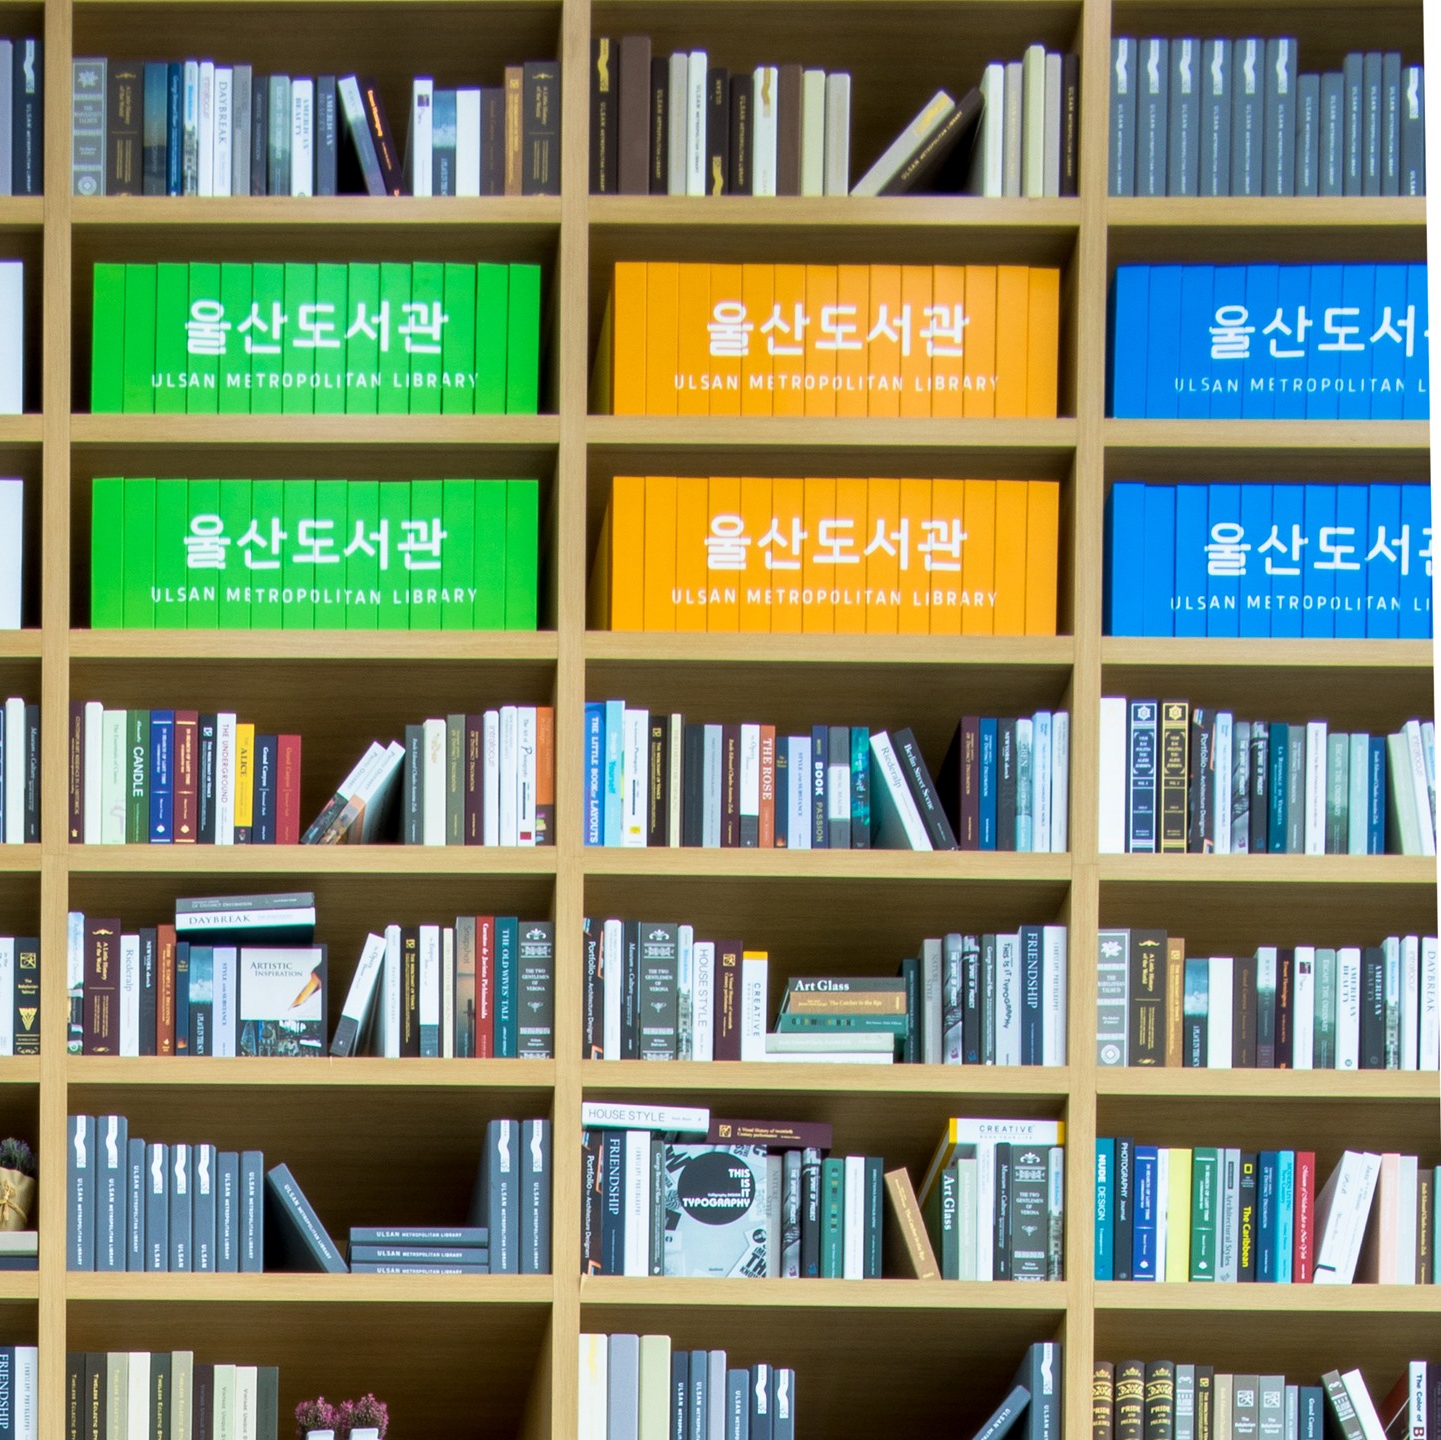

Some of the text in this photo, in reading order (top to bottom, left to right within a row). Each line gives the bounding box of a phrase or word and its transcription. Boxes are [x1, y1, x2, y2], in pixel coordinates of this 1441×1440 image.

[185, 299, 449, 354] 울산도서관
[706, 301, 970, 358] 울산도서관
[1209, 305, 1426, 359] 울산도서
[151, 372, 479, 390] ULSAN METROPOLITAN LIBRARY
[674, 373, 1000, 393] ULSAN METROPOLITAN LIBRARY
[1174, 377, 1239, 394] ULSAN
[1250, 377, 1407, 395] METROPOLITAN
[184, 513, 448, 570] 울산도서관
[704, 513, 968, 573] 울산도서관
[151, 586, 478, 605] ULSAN METROPOLITAN LIBRARY
[672, 588, 997, 608] ULSAN METROPOLITAN LIBRARY
[132, 747, 143, 798] CANDLE
[221, 741, 229, 803] UNDERGROUND
[762, 738, 772, 800] THE ROSE
[189, 913, 251, 925] DAYBREAK
[250, 961, 294, 969] ARTISTIC
[254, 969, 303, 977] INSPIRATION
[1027, 933, 1038, 1008] FRIENDSHIP
[795, 980, 850, 991] Art Glass
[753, 982, 761, 1037] CREATIVE
[728, 1168, 751, 1179] THIS
[740, 1179, 751, 1189] IS
[741, 1188, 751, 1198] IT
[1098, 1154, 1106, 1220] NUDE DESIGN
[682, 1197, 751, 1209] TYPOGRAPHY
